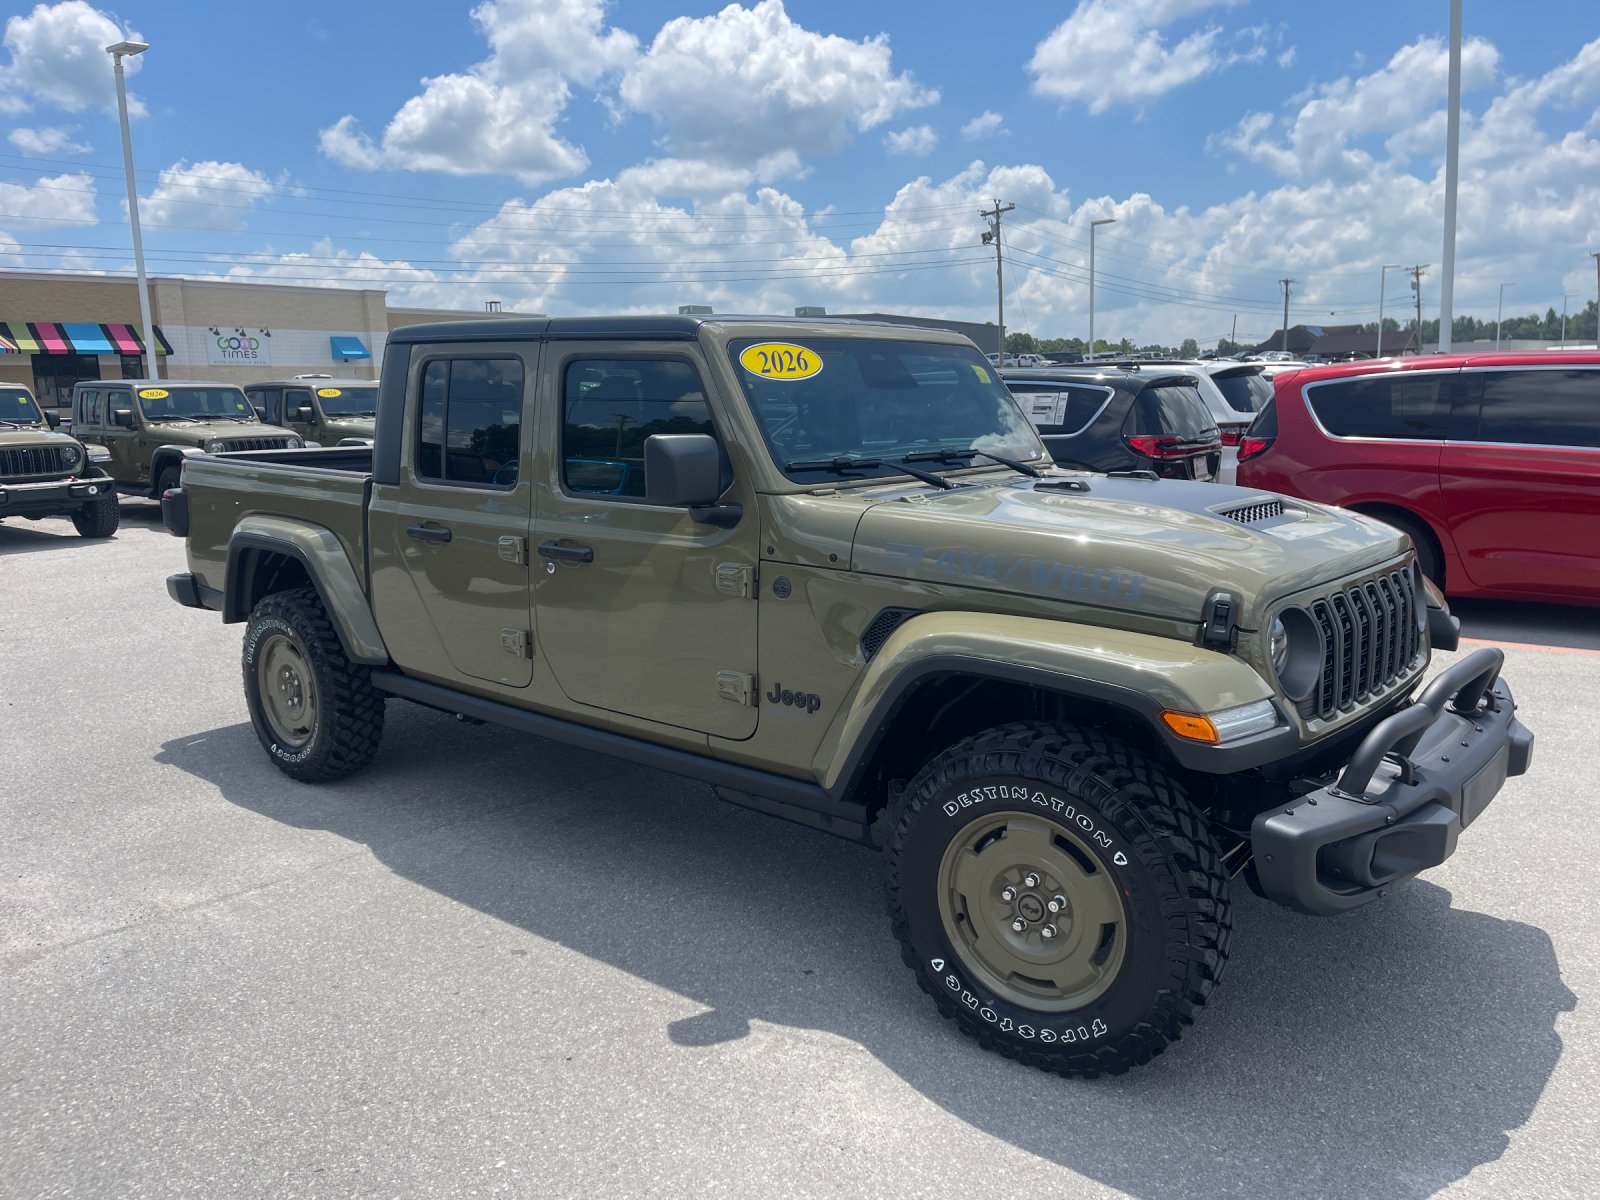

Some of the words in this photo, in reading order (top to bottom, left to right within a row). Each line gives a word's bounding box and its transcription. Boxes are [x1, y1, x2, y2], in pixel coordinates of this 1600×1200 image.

[217, 337, 259, 350] GOOD
[221, 350, 258, 359] TIMES
[757, 350, 808, 373] 2026
[766, 682, 821, 714] Jeep
[943, 785, 1112, 848] DESTINATION
